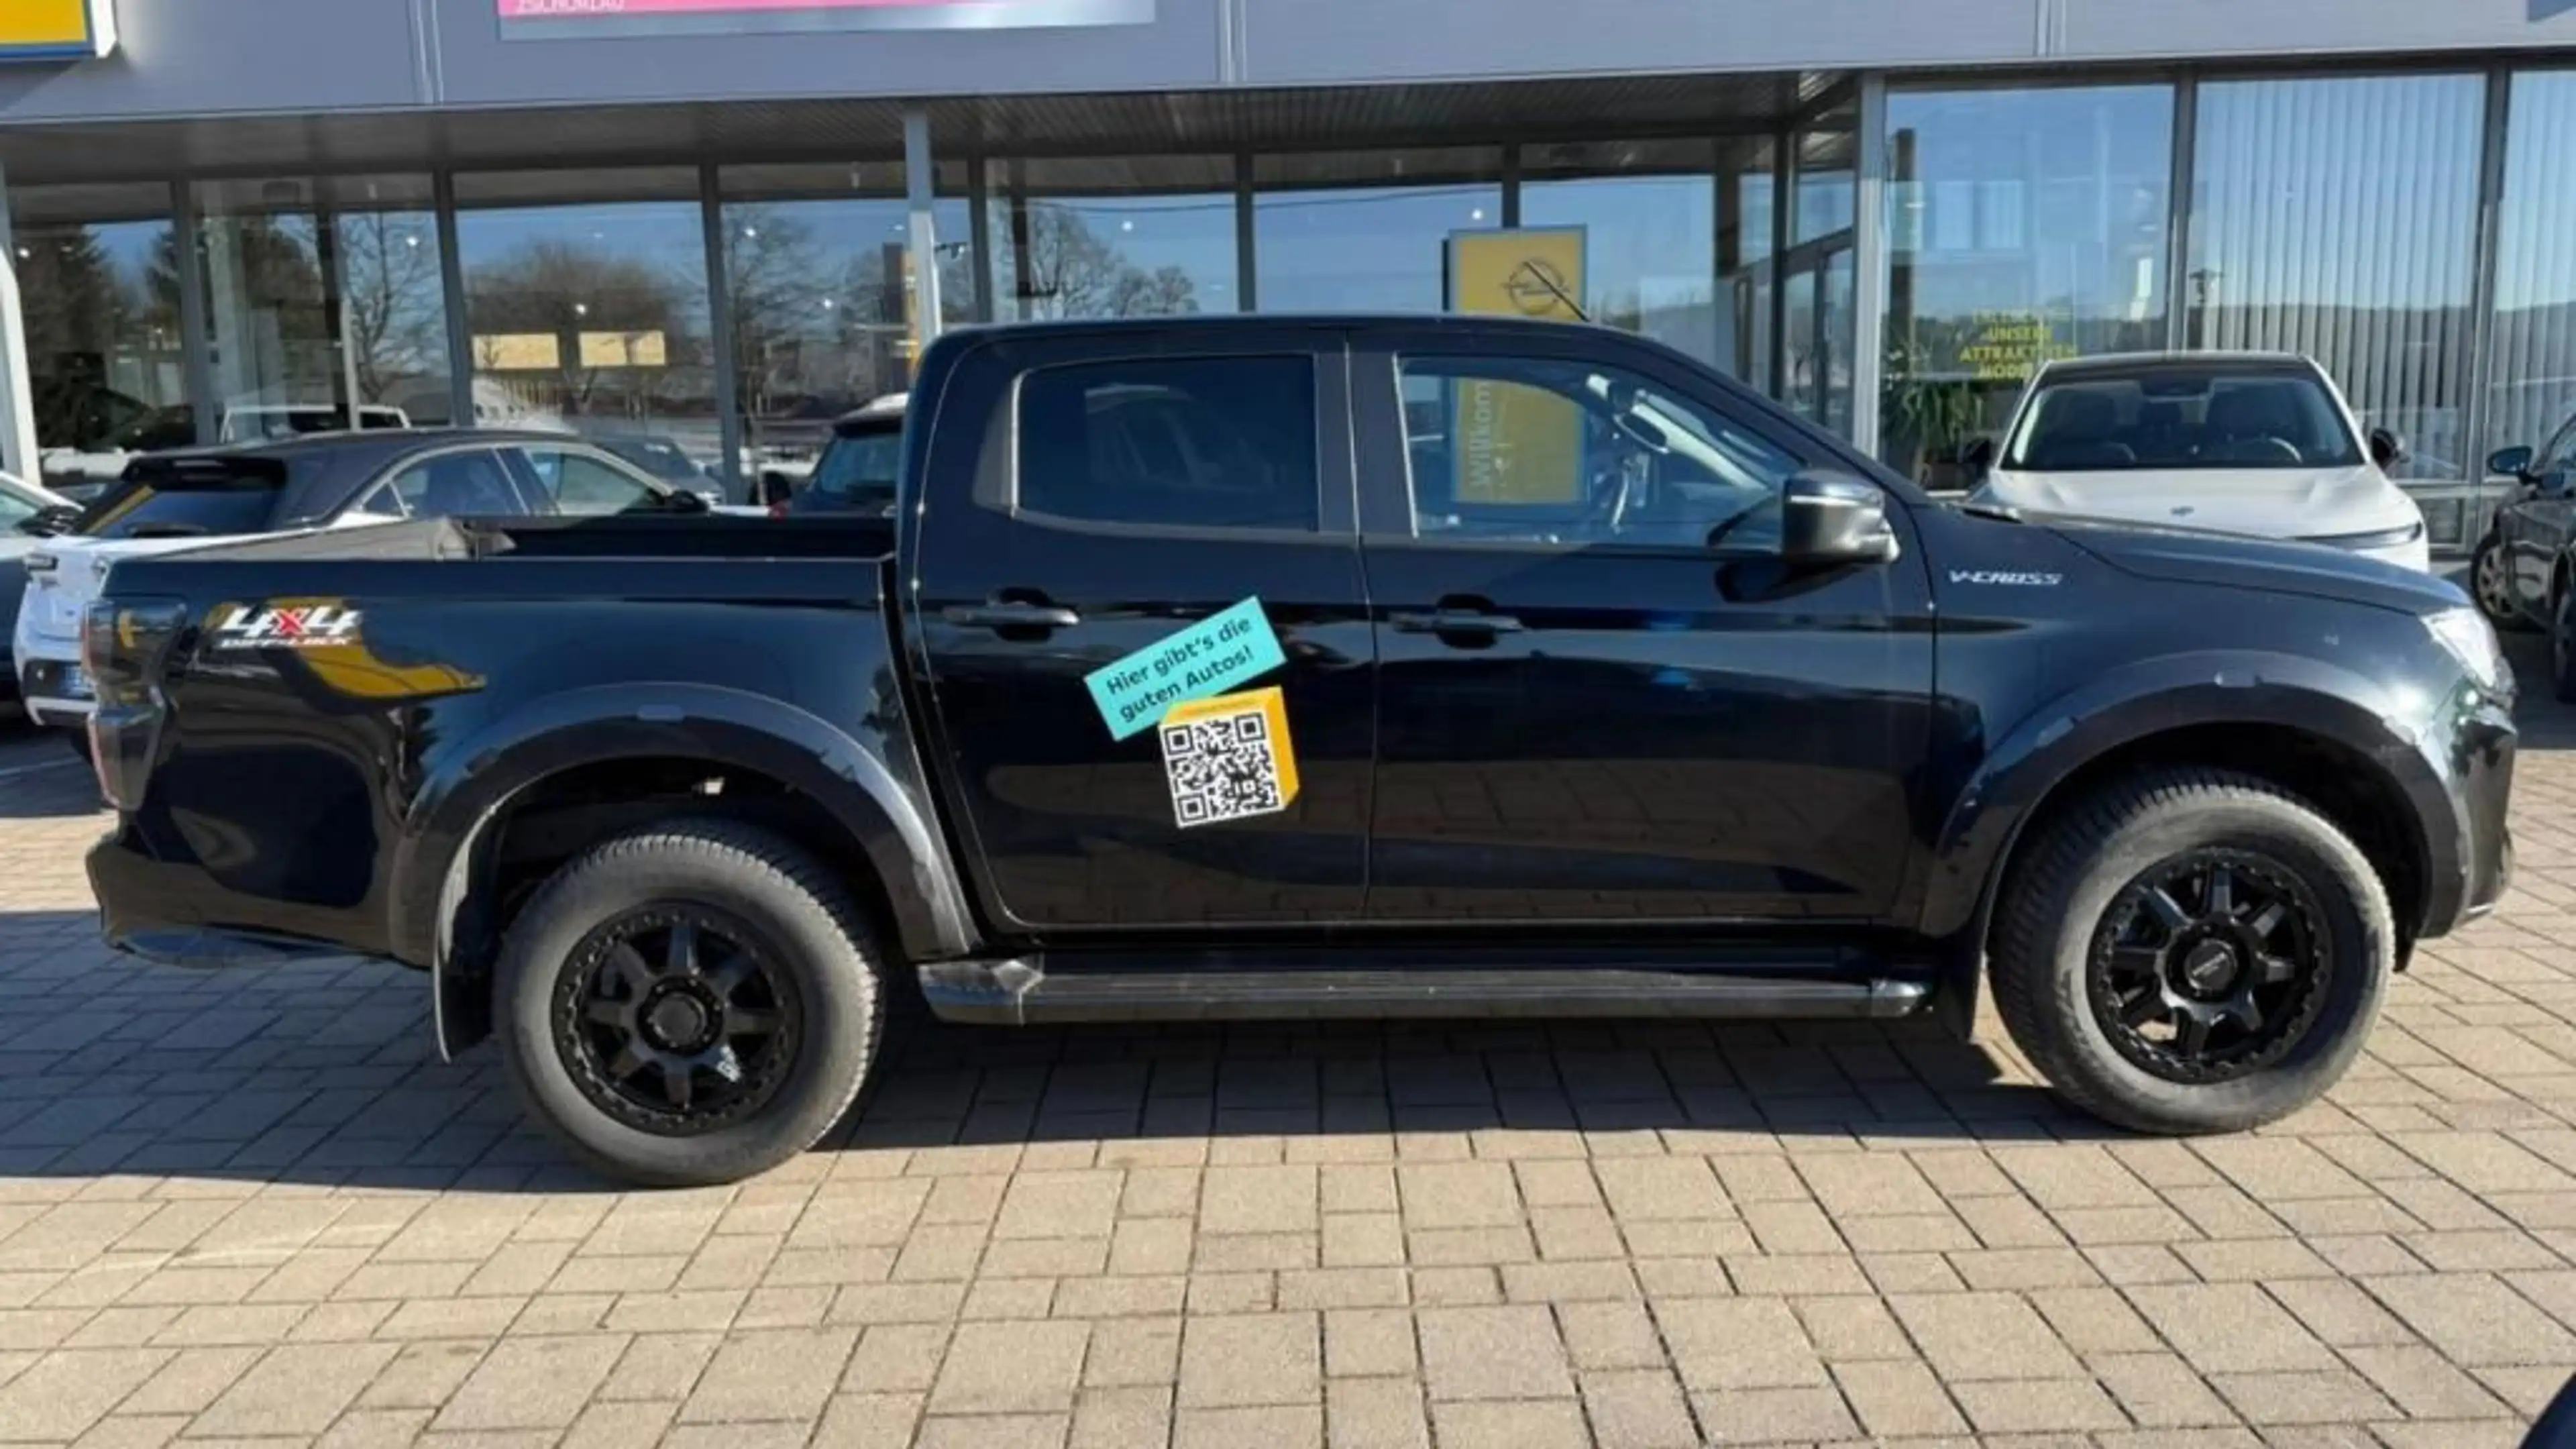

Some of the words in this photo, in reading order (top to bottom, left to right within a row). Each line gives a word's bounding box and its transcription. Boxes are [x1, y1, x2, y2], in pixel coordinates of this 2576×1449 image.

[1949, 570, 2063, 585] V-CROSS
[1106, 664, 1150, 696] Hier
[1218, 616, 1252, 643] die
[1119, 682, 1182, 723] guten
[1186, 644, 1255, 690] Autos!
